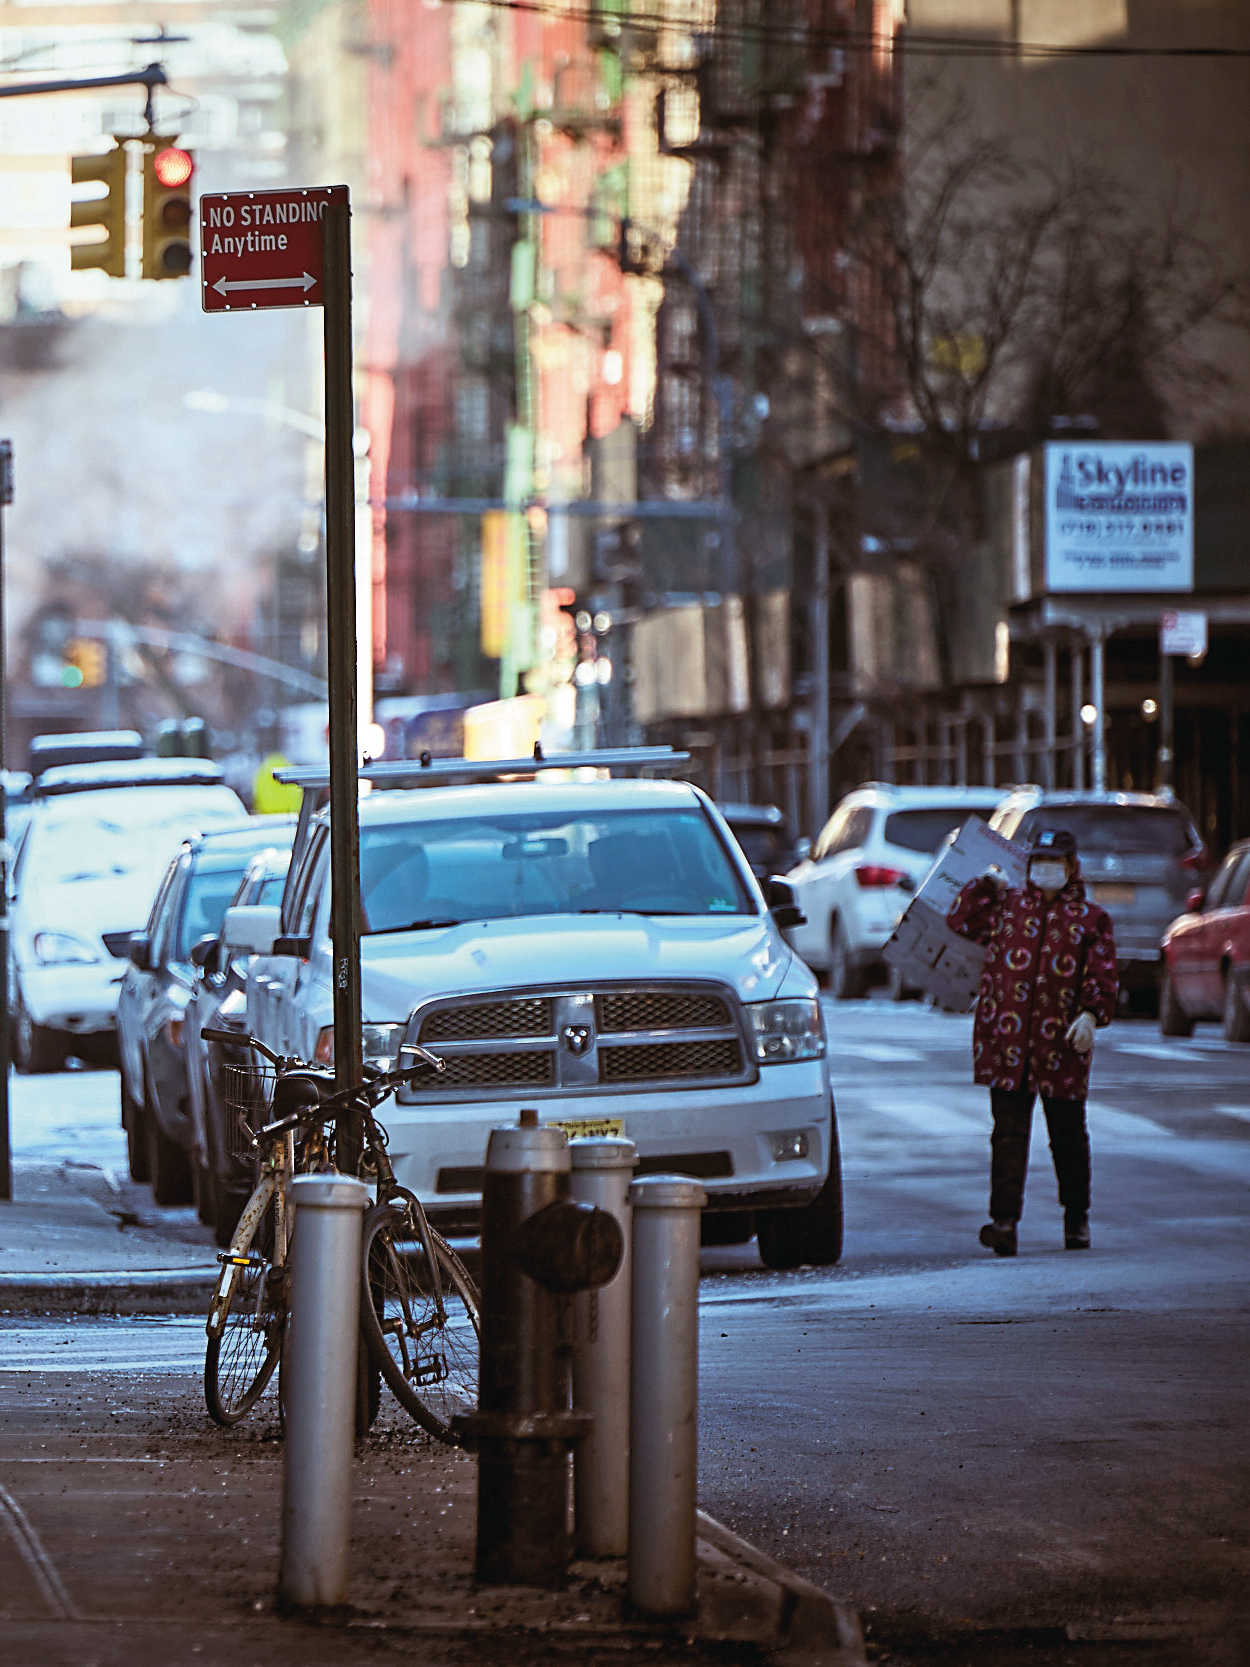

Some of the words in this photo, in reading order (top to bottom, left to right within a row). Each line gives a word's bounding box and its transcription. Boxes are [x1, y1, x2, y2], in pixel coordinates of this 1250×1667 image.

[209, 206, 235, 228] NO
[211, 231, 288, 257] Anytime
[1076, 453, 1187, 496] Skyline
